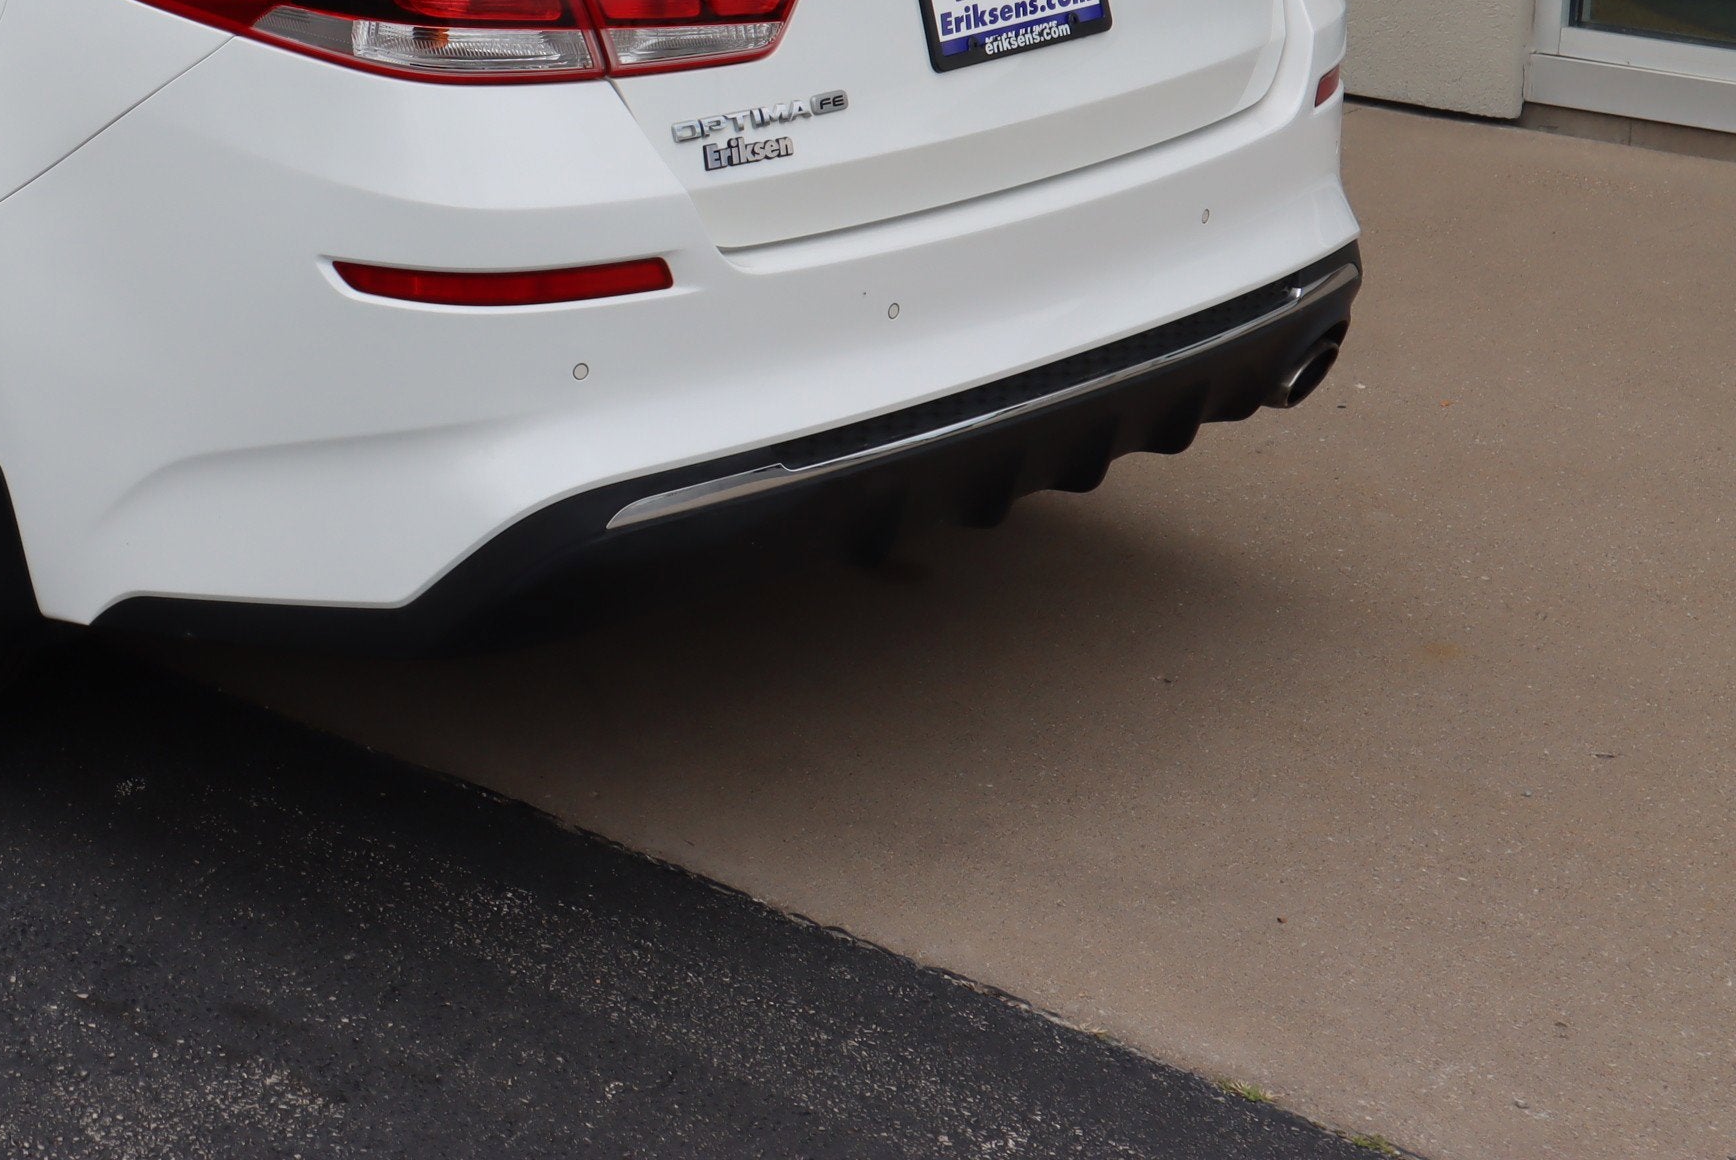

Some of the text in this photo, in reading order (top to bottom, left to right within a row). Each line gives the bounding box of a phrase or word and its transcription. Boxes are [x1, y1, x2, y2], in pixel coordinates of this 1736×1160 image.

[985, 23, 1071, 55] eriksens.com
[671, 94, 844, 143] OPTIMA FE
[702, 136, 795, 171] Eriksen
